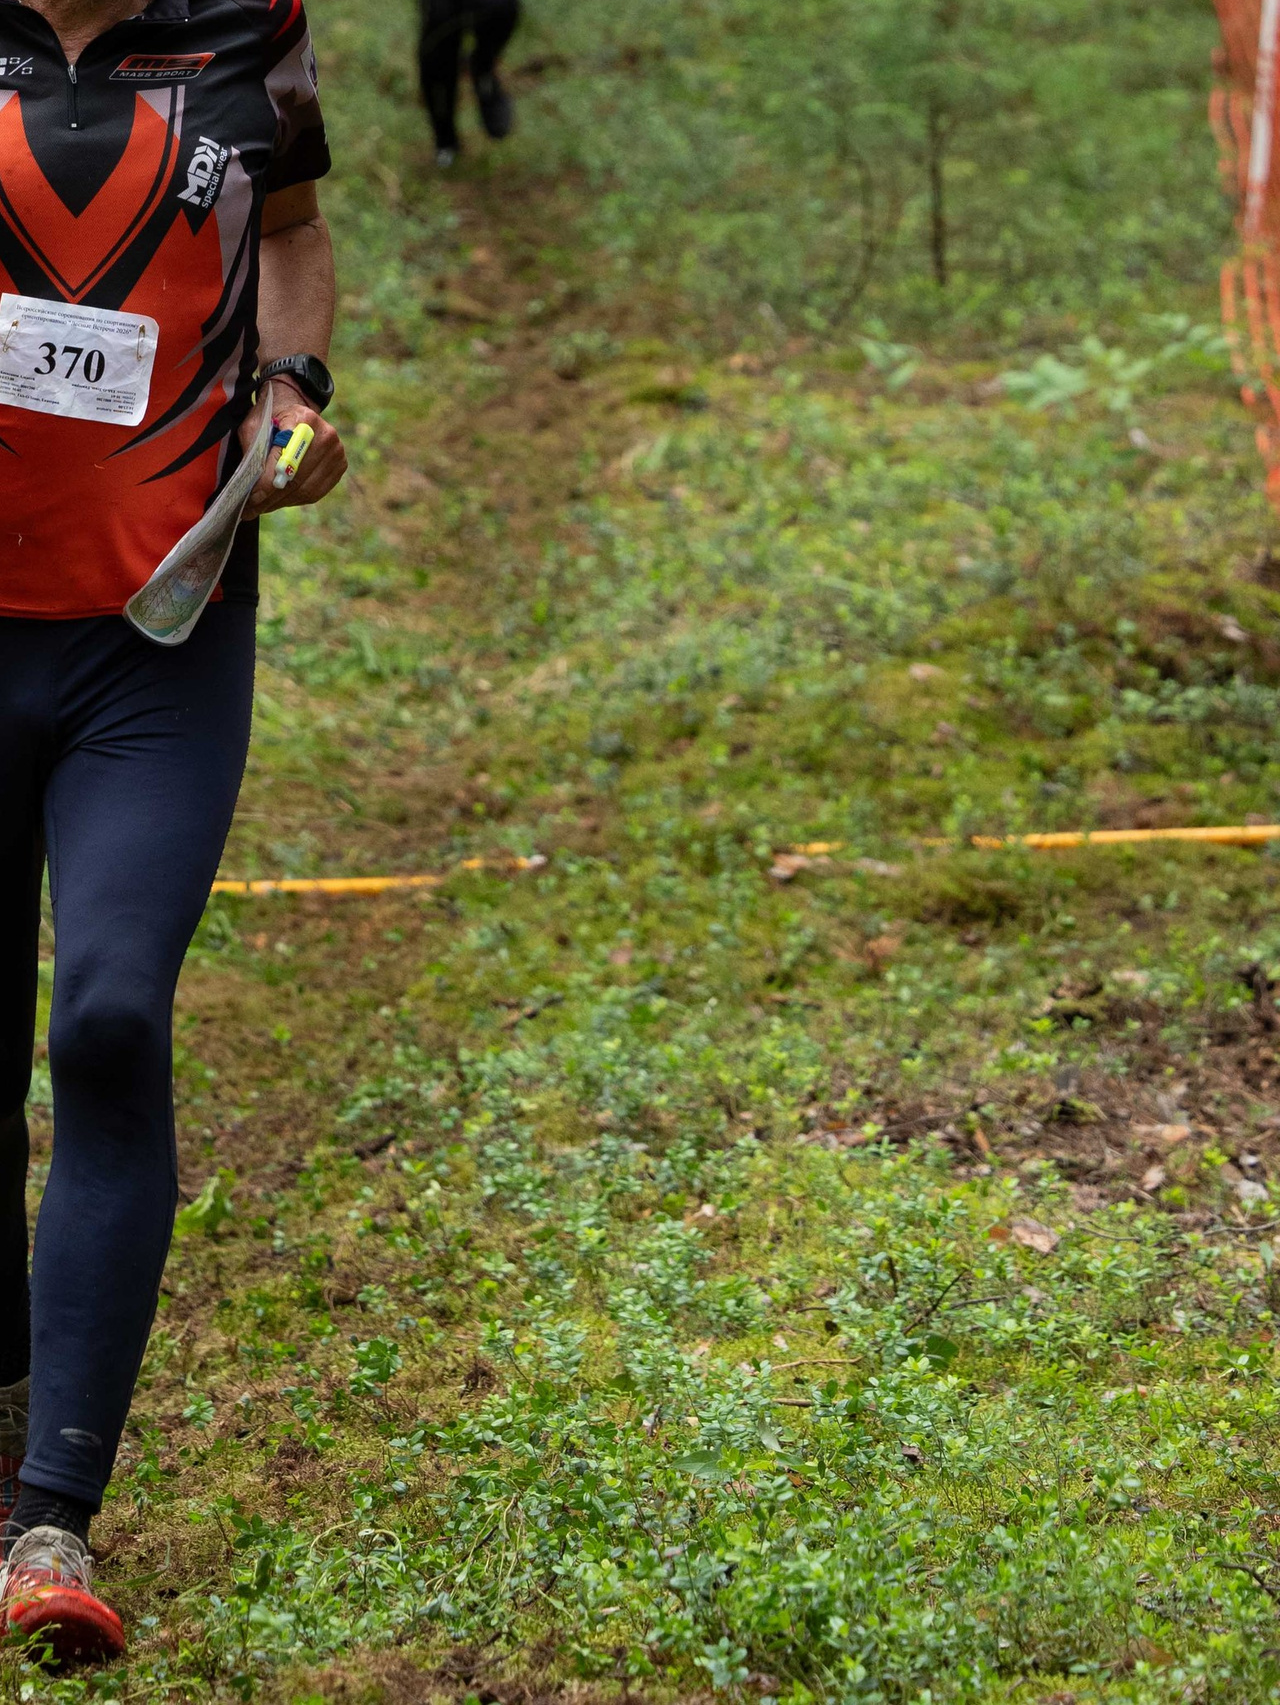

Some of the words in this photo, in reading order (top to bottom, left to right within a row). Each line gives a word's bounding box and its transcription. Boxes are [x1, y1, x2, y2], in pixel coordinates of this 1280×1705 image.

[156, 70, 193, 78] SPORT
[201, 171, 220, 209] special
[216, 146, 228, 171] wear
[34, 342, 106, 384] 370
